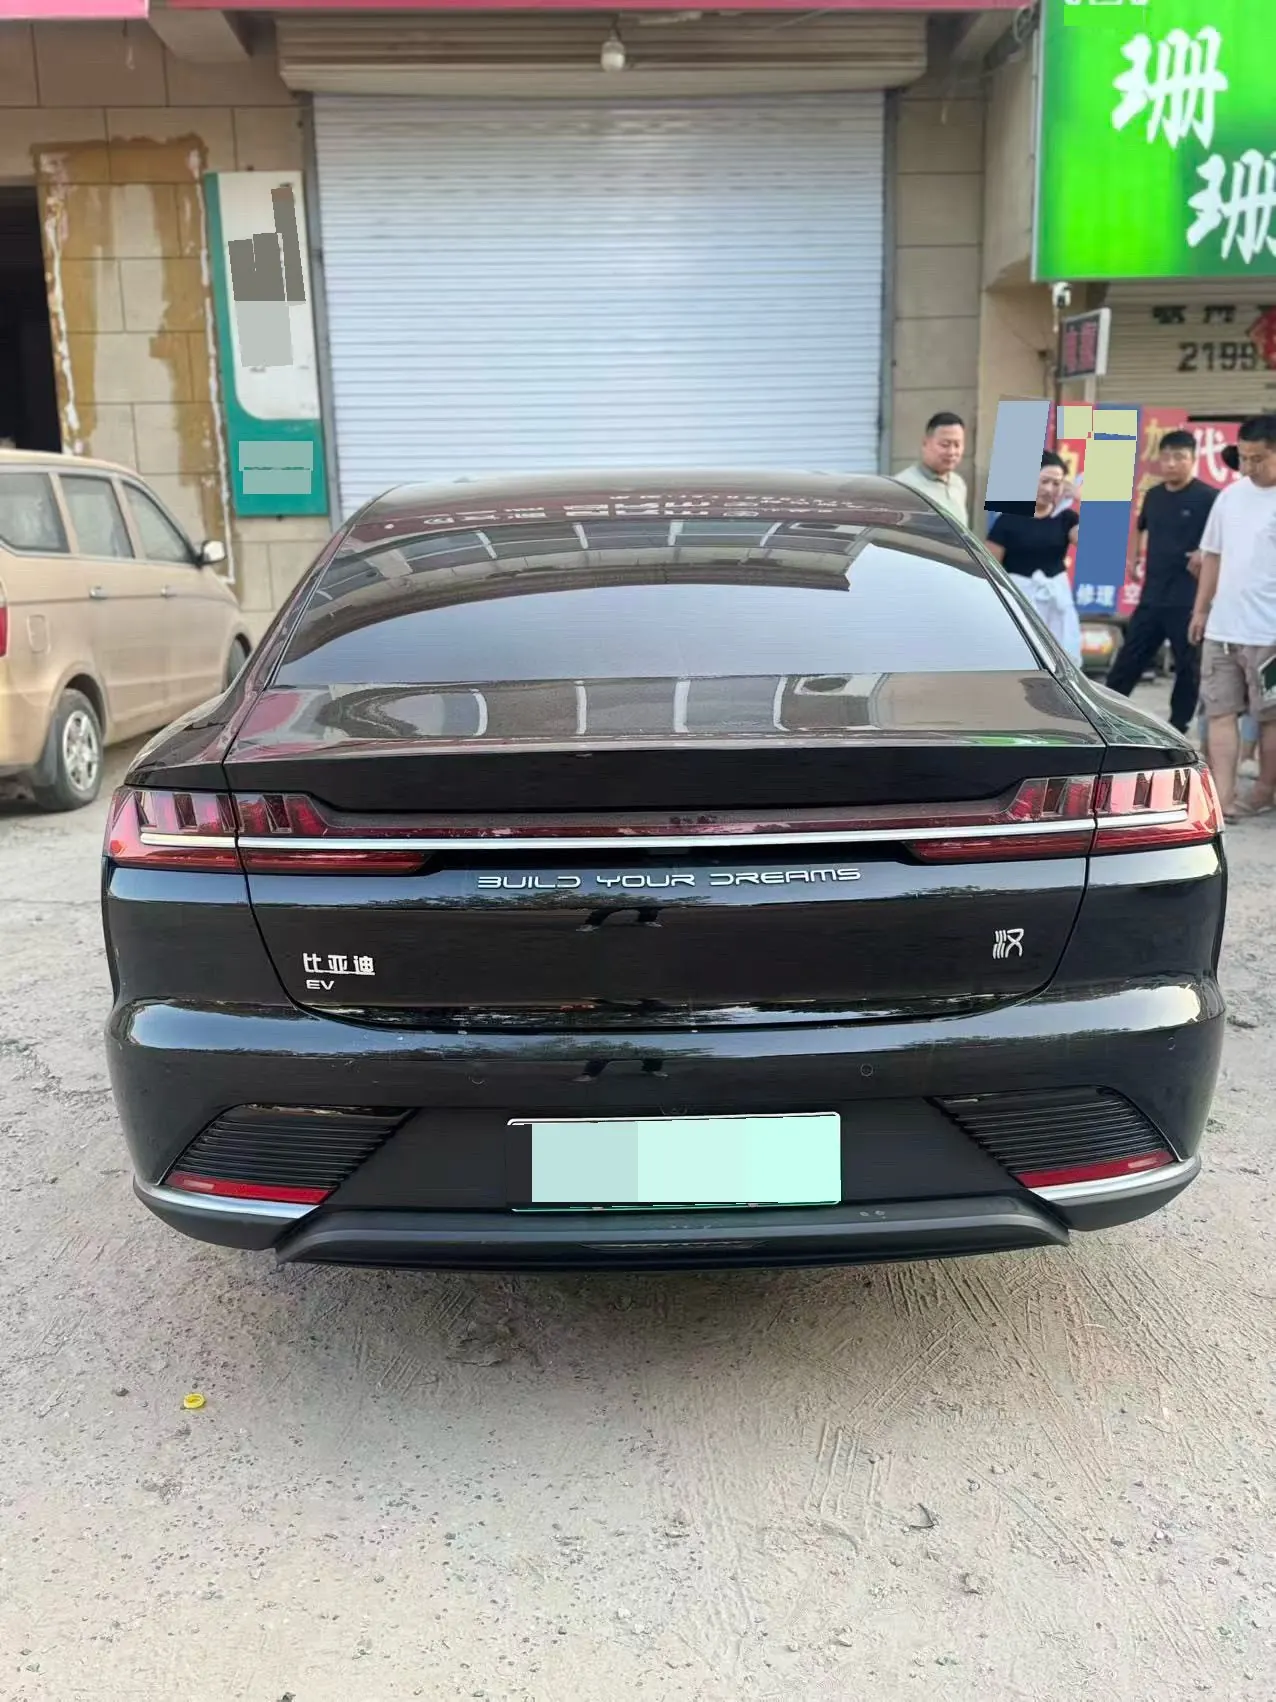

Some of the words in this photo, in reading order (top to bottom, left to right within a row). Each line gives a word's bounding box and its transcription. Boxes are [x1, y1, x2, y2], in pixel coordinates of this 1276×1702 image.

[1111, 25, 1229, 150] 珊
[1186, 149, 1276, 265] 珊
[1178, 341, 1276, 372] 2199
[477, 875, 580, 889] BUILD
[596, 873, 696, 888] YOUR
[709, 868, 862, 886] DREAMS
[302, 952, 376, 976] 比亚迪
[306, 979, 335, 990] EV
